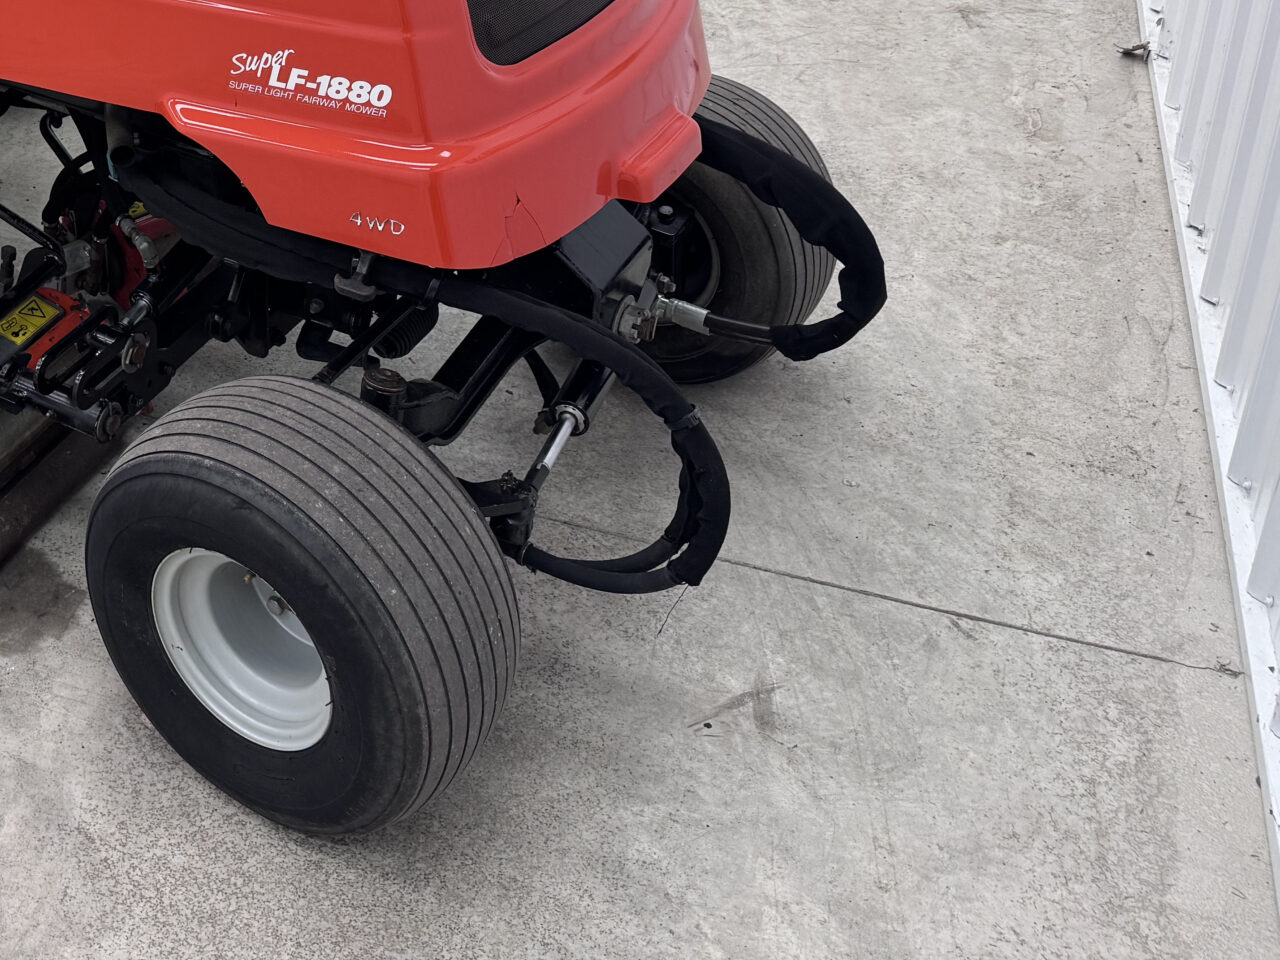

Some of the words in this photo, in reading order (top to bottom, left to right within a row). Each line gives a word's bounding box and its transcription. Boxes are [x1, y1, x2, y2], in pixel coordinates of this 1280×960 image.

[230, 49, 295, 78] Super
[228, 80, 263, 94] SUPER
[264, 87, 295, 100] LIGHT
[296, 93, 342, 109] FAIRWAY
[344, 102, 387, 118] MOWER
[268, 63, 393, 108] LF-1880
